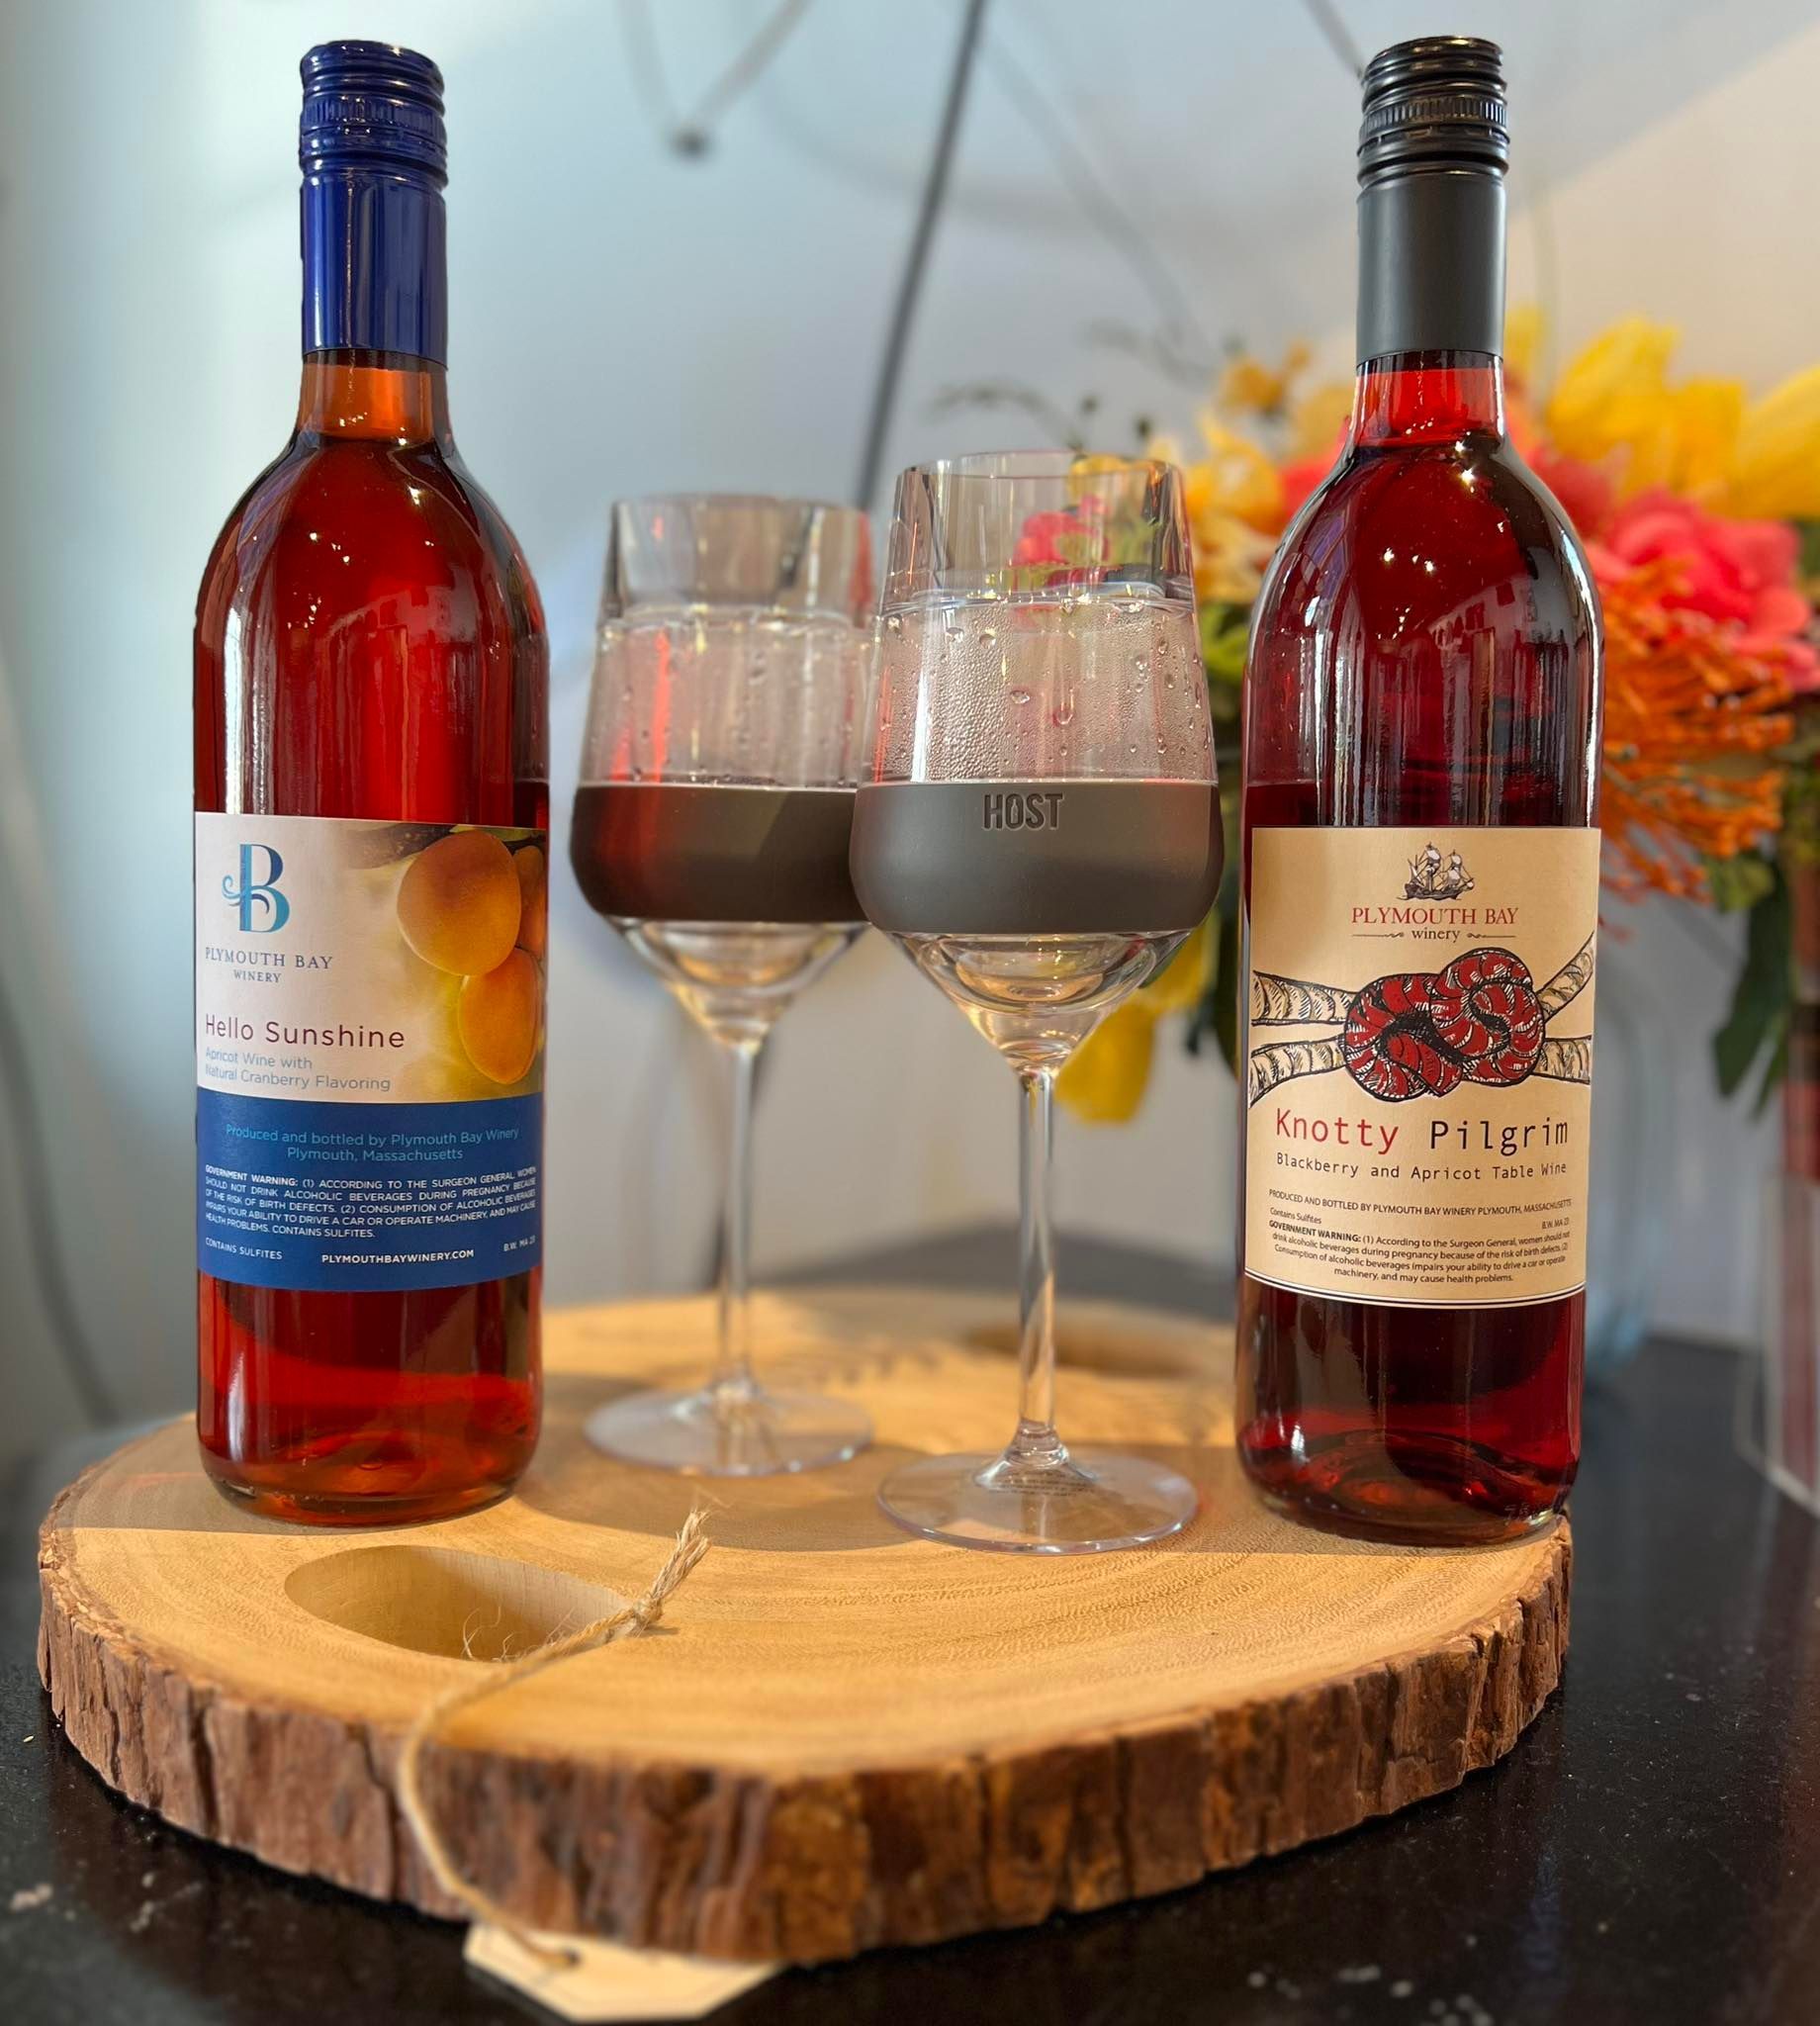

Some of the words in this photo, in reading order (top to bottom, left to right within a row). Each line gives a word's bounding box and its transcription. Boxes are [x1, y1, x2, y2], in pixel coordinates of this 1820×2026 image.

[983, 792, 1064, 829] HOST
[1351, 907, 1476, 925] PLYMOUTH
[1485, 907, 1519, 925] BAY
[1411, 928, 1461, 943] winery
[206, 947, 286, 967] PLYMOUTH
[296, 956, 333, 969] BAY
[233, 969, 281, 983] WINERY
[206, 1014, 253, 1041] Hello
[265, 1021, 405, 1048] Sunshine
[206, 1047, 237, 1063] Apricot
[242, 1052, 275, 1066] Wine
[280, 1057, 313, 1068] with
[206, 1063, 237, 1080] Natural
[240, 1069, 310, 1089] Cranberry
[317, 1075, 391, 1092] Flavoring
[226, 1124, 278, 1141] Produced
[282, 1132, 307, 1143] and
[312, 1133, 363, 1146] bottled
[369, 1135, 386, 1147] by
[392, 1133, 457, 1147] Plymouth
[461, 1132, 483, 1144] Bay
[486, 1128, 519, 1141] Winery
[1276, 1108, 1399, 1154] Knotty
[1430, 1117, 1568, 1156] Pilgrim
[288, 1148, 358, 1162] Plymouth,
[363, 1149, 463, 1161] Massachusetts
[1277, 1152, 1359, 1177] Blackberry
[1371, 1165, 1400, 1177] and
[1410, 1165, 1481, 1182] Apricot
[1493, 1165, 1533, 1179] Table
[1541, 1162, 1567, 1175] Wine
[205, 1176, 228, 1189] SHOULD
[230, 1183, 247, 1193] NOT
[251, 1186, 279, 1197] DRINK
[284, 1190, 343, 1200] ALCOHOLIC
[419, 1190, 457, 1200] DURING
[462, 1184, 510, 1197] PREGNANCY
[513, 1177, 536, 1190] BECAUSE
[206, 1164, 247, 1181] GOVERNMENT
[251, 1174, 298, 1186] WARNING:
[303, 1179, 315, 1188] (1)
[318, 1180, 383, 1189] ACCORDING
[388, 1180, 403, 1189] TO
[432, 1177, 477, 1187] SURGEON
[214, 1190, 226, 1201] THE
[227, 1194, 242, 1204] RISK
[244, 1197, 256, 1206] OF
[259, 1197, 286, 1209] BIRTH
[289, 1202, 336, 1212] DEFECTS.
[340, 1205, 356, 1214] (2)
[359, 1204, 436, 1214] CONSUMPTION
[439, 1202, 454, 1212] OF
[456, 1196, 503, 1210] ALCOHOLIC
[228, 1207, 247, 1217] YOUR
[248, 1210, 282, 1222] ABILITY
[284, 1214, 298, 1223] TO
[299, 1215, 329, 1225] DRIVE
[342, 1217, 365, 1226] CAR
[367, 1217, 383, 1226] OR
[385, 1216, 434, 1226] OPERATE
[435, 1211, 489, 1224] MACHINERY,
[490, 1209, 505, 1218] AND
[506, 1206, 519, 1215] MAY
[519, 1200, 536, 1212] CAUSE
[1269, 1189, 1303, 1202] PRODUCED
[1305, 1196, 1320, 1206] AND
[1322, 1199, 1359, 1210] BOTTLED
[1360, 1203, 1372, 1212] BY
[1373, 1204, 1421, 1215] PLYMOUTH
[1442, 1207, 1476, 1216] WINERY
[205, 1212, 227, 1225] HEALTH
[227, 1218, 270, 1233] PROBLEMS.
[272, 1225, 322, 1237] CONTAINS
[324, 1229, 376, 1238] SULFITES.
[1270, 1207, 1296, 1219] Contains
[1297, 1213, 1321, 1224] Sulfites
[1269, 1220, 1317, 1236] GOVERNMENT
[1318, 1230, 1361, 1243] WARNING:
[1376, 1237, 1419, 1248] According
[1433, 1239, 1448, 1247] the
[1449, 1240, 1484, 1249] Surgeon
[1486, 1238, 1517, 1247] General,
[1544, 1232, 1562, 1243] should
[206, 1238, 237, 1253] CONTAINS
[239, 1245, 283, 1259] SULFITES
[321, 1249, 475, 1263] PLYMOUTHBAYWINERY.COM
[1275, 1243, 1318, 1258] Consumption
[1328, 1254, 1364, 1266] alcoholic
[1366, 1259, 1410, 1270] beverages
[1412, 1262, 1443, 1271] impairs
[1467, 1262, 1491, 1272] ability
[1289, 1236, 1318, 1248] alcoholic
[1320, 1242, 1359, 1254] beverages
[1361, 1248, 1390, 1258] during
[1392, 1250, 1438, 1259] pregnancy
[1440, 1250, 1475, 1259] because
[1524, 1247, 1539, 1256] birth
[1334, 1268, 1379, 1281] machinery,
[1381, 1272, 1398, 1281] and
[1400, 1274, 1418, 1284] may
[1446, 1273, 1474, 1283] health
[1475, 1273, 1513, 1284] problems.
